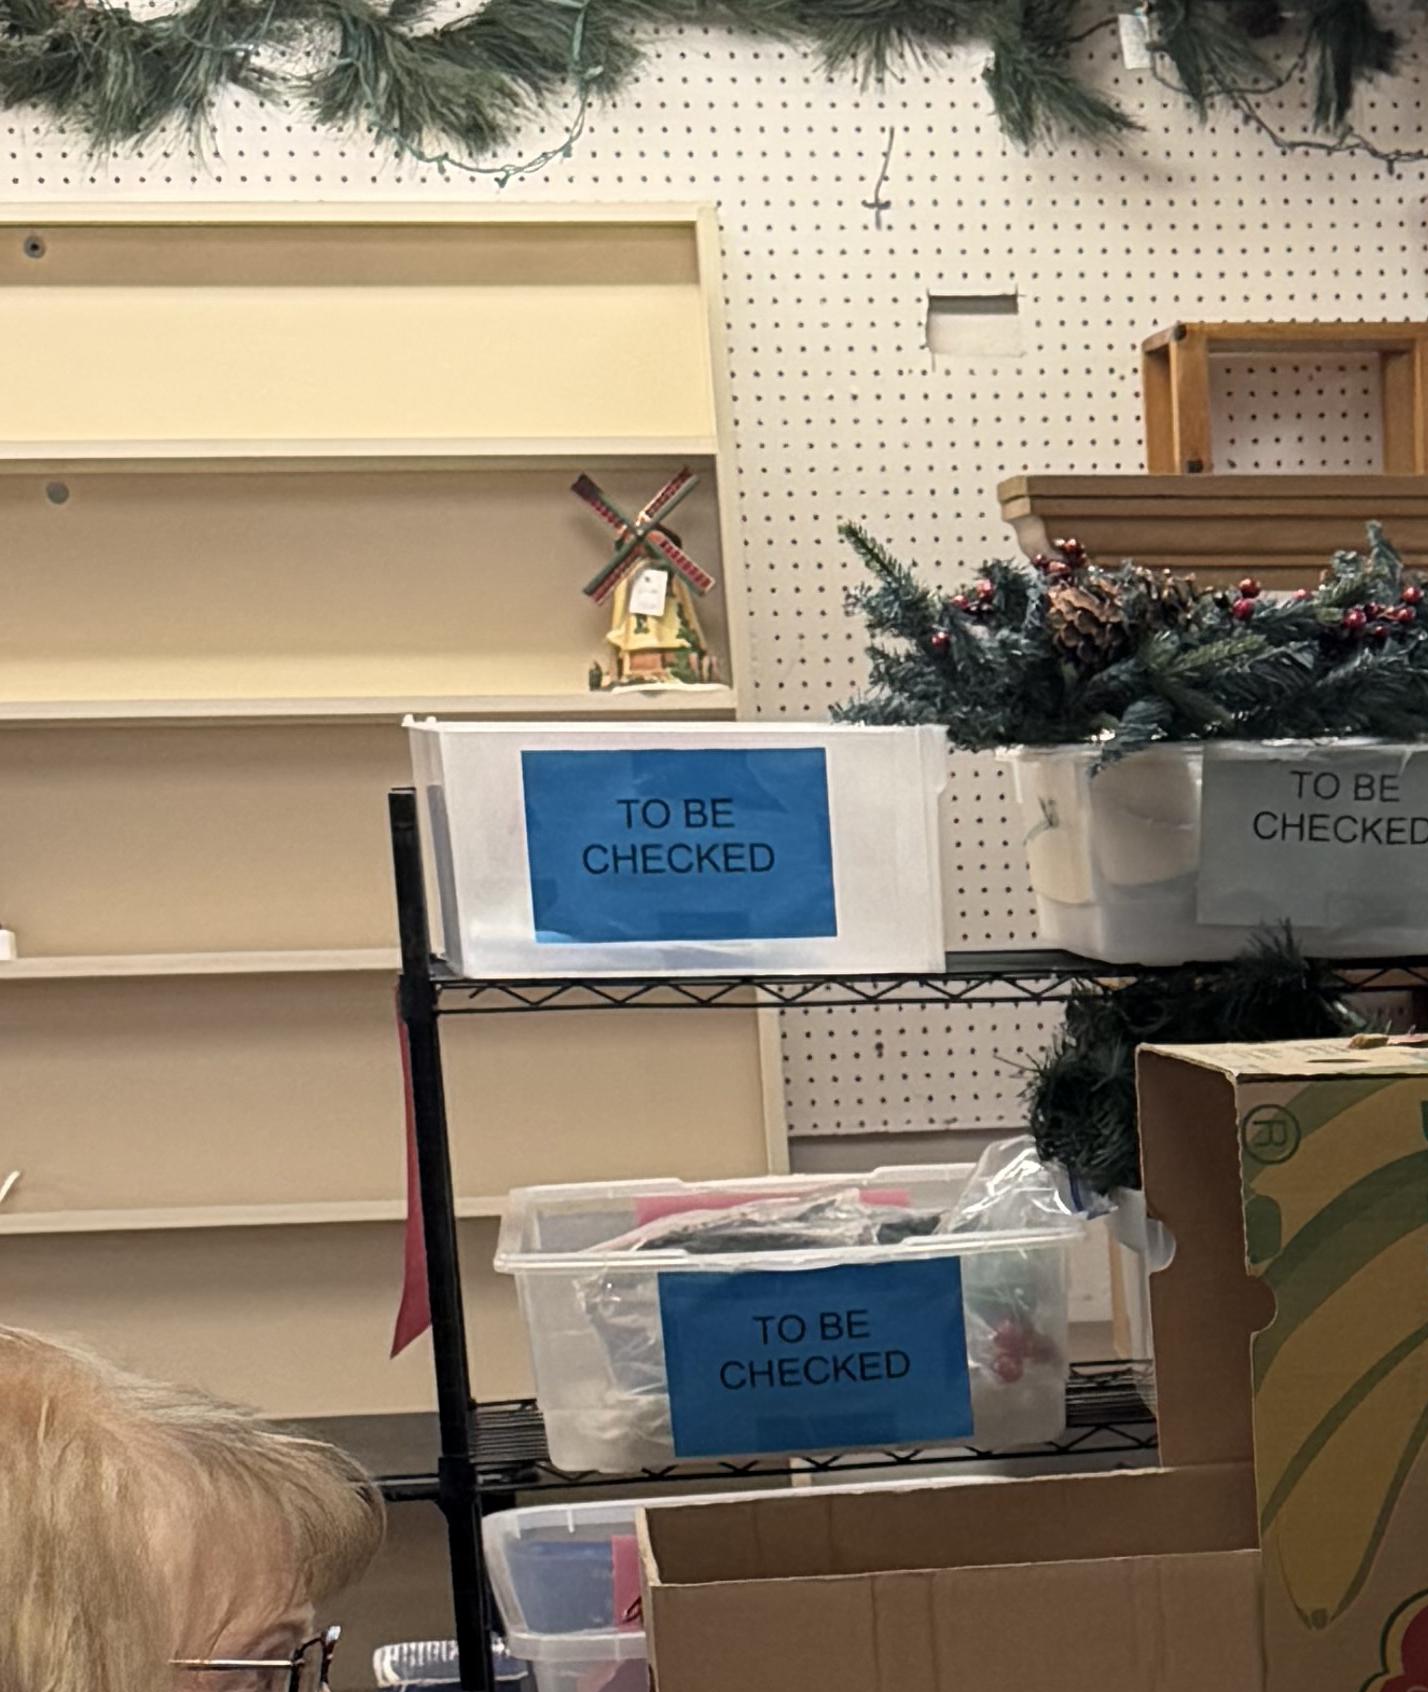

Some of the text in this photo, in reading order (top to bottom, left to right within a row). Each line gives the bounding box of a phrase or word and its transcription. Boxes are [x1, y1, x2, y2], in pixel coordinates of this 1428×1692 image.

[1289, 769, 1401, 803] TO BE
[616, 796, 735, 830] TO BE
[581, 841, 776, 876] CHECKED
[752, 1308, 871, 1346] TO BE
[718, 1349, 911, 1392] CHECKED
